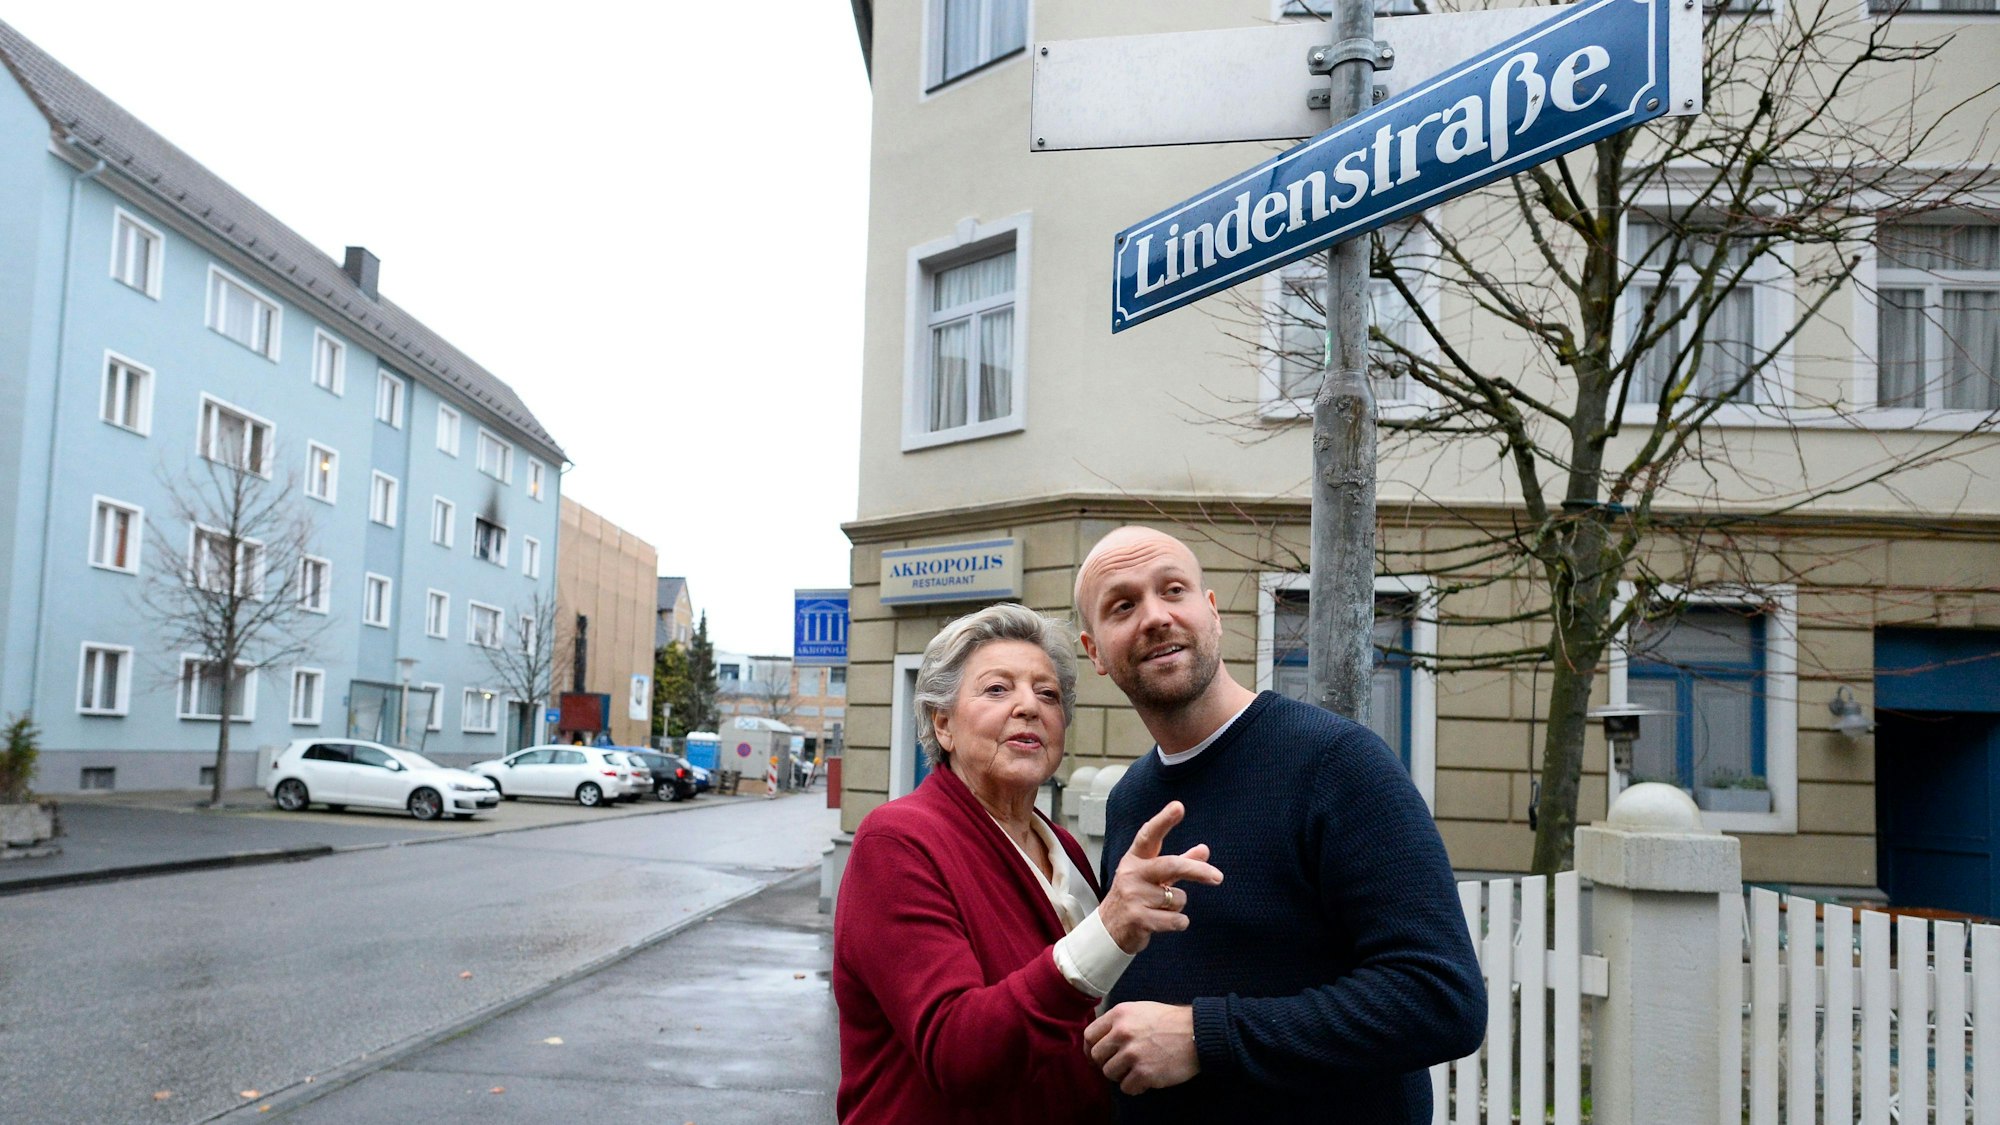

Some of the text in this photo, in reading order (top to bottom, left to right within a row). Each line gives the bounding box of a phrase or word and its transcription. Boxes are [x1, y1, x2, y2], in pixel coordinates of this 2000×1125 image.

[1134, 45, 1610, 299] Lindenstraße
[890, 554, 1003, 578] AKROPOLIS
[912, 575, 975, 588] RESTAURANT
